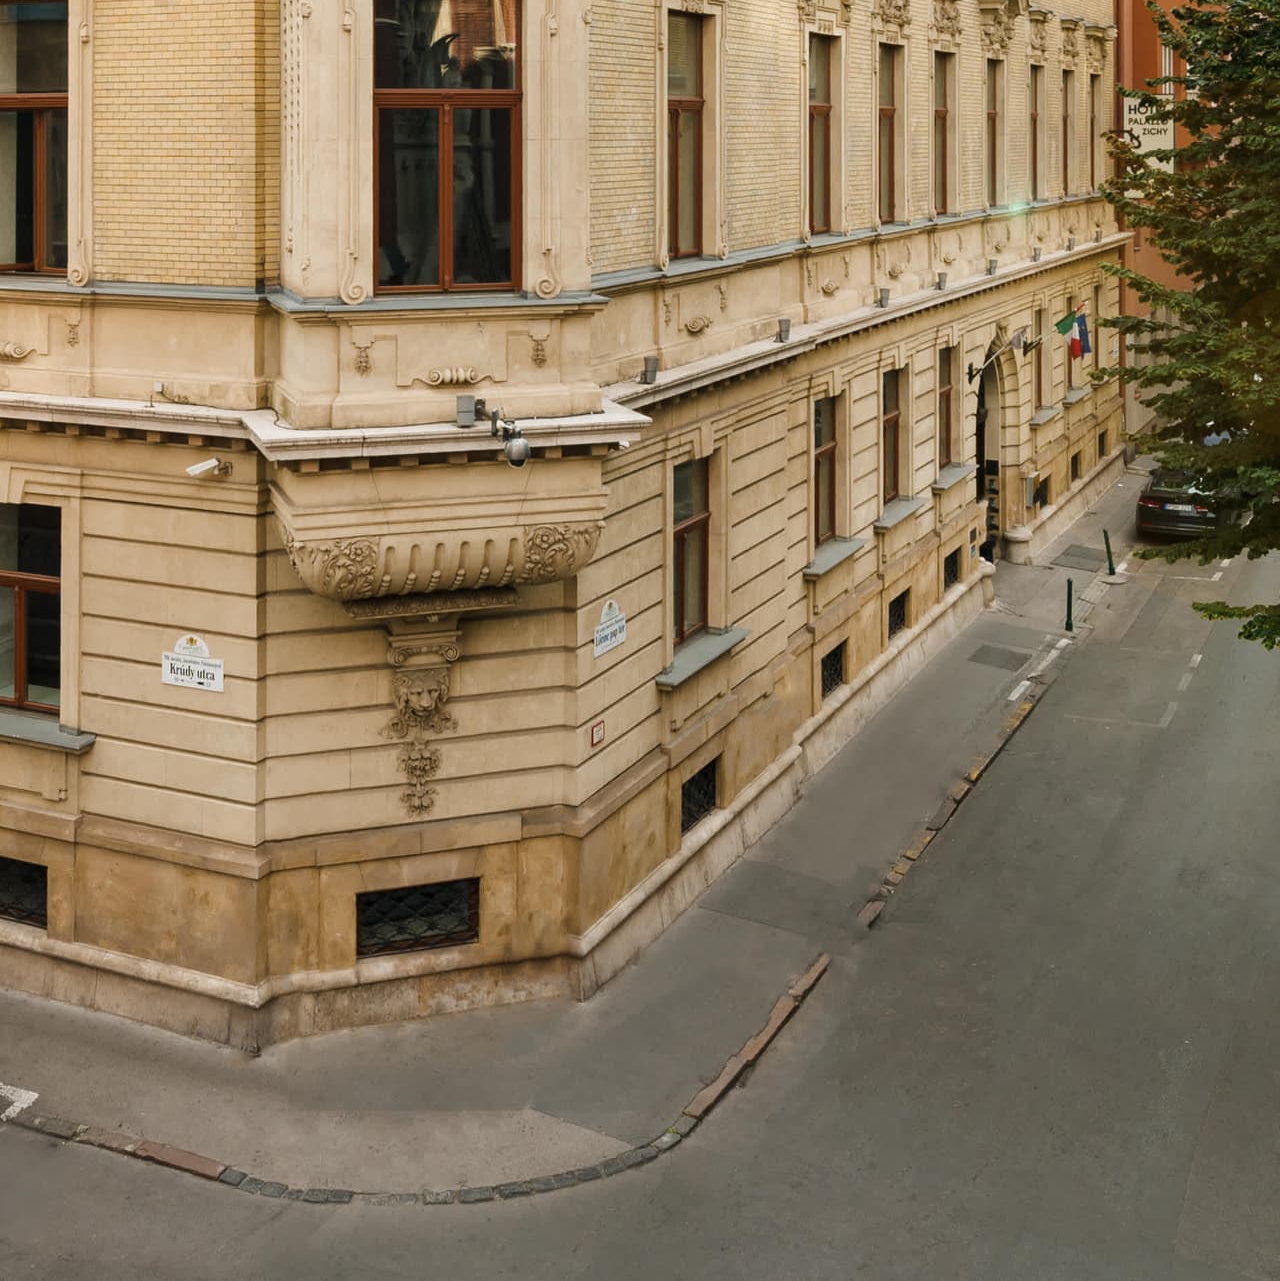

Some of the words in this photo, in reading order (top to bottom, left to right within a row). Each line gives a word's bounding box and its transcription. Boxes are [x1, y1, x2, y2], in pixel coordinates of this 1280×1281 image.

[1142, 127, 1168, 136] ZICHY
[170, 662, 194, 680] Krúdy
[197, 669, 215, 681] utca
